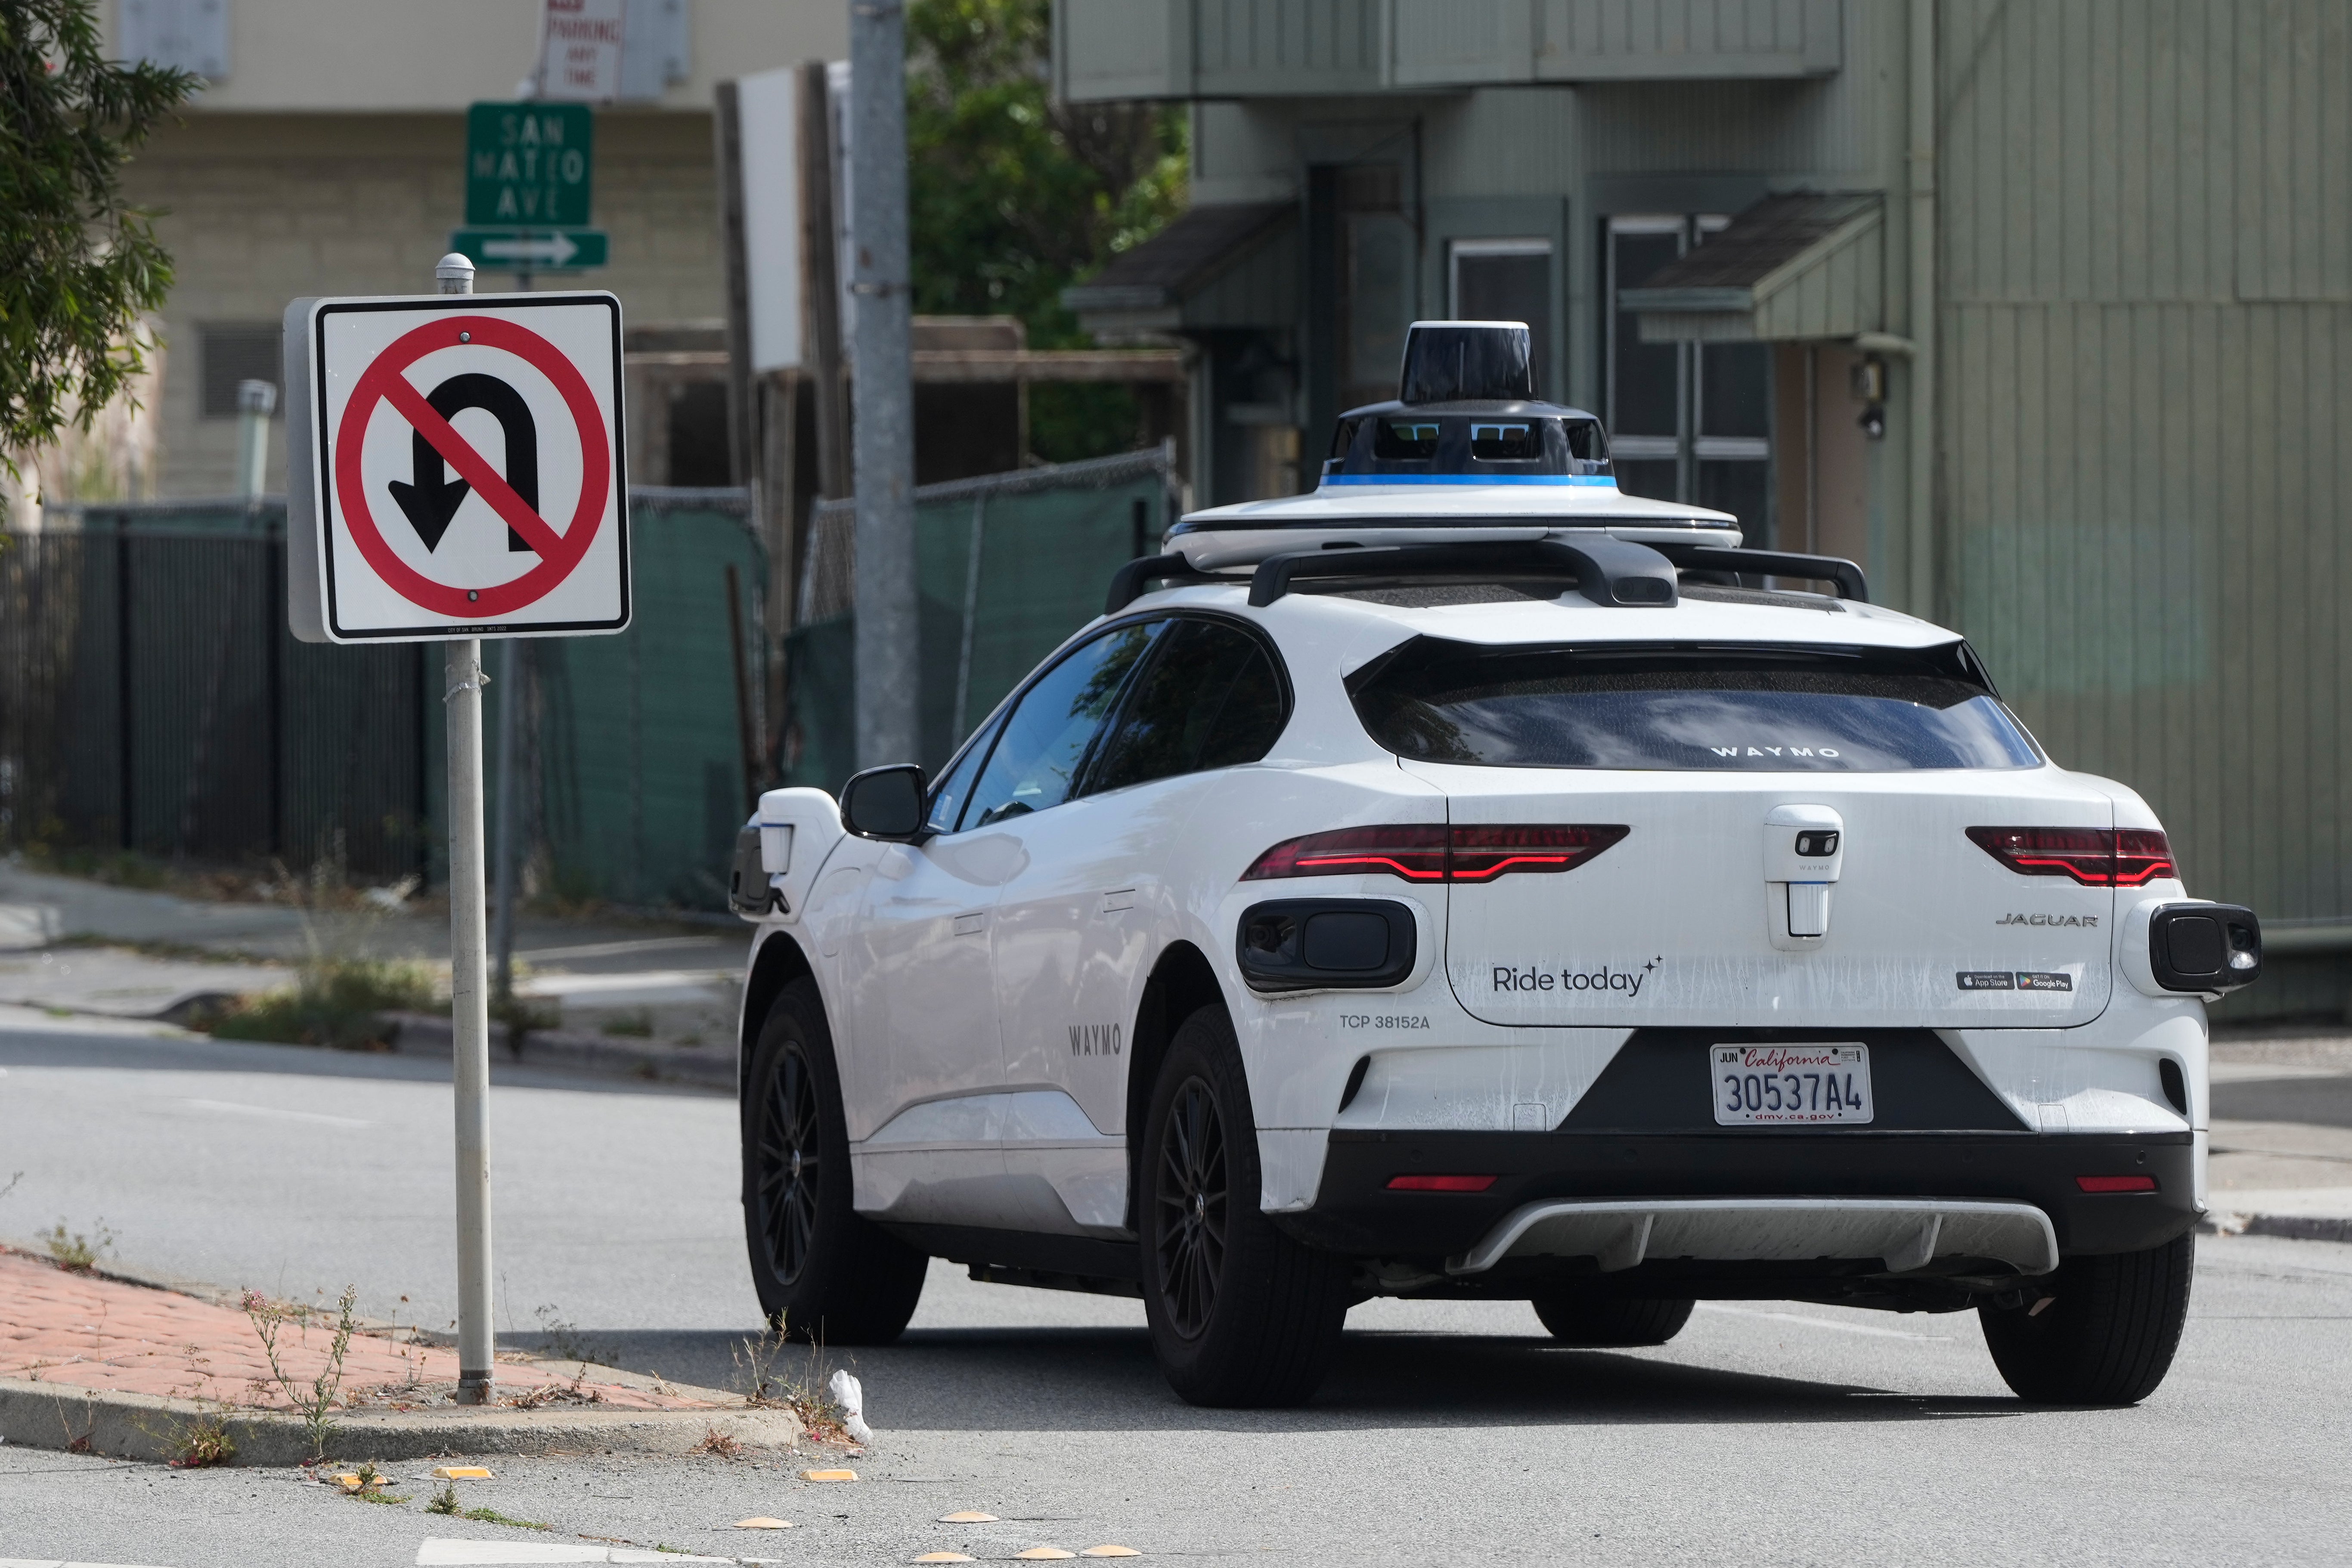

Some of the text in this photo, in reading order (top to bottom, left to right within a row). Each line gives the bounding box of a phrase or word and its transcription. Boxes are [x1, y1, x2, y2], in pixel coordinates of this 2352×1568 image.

[501, 114, 564, 146] SAN
[473, 149, 584, 184] MATEO
[496, 186, 559, 219] AVE
[1710, 747, 1839, 757] WAYMO
[1996, 913, 2098, 927] JAGUAR
[1493, 966, 1643, 997] Ride today
[2033, 979, 2068, 989] Google Play
[1340, 1015, 1430, 1029] TCP 38152A
[1069, 1023, 1120, 1056] WAYMO
[1720, 1053, 1738, 1063] JUN
[1745, 1048, 1841, 1072] California
[1724, 1074, 1862, 1111] 30537A4
